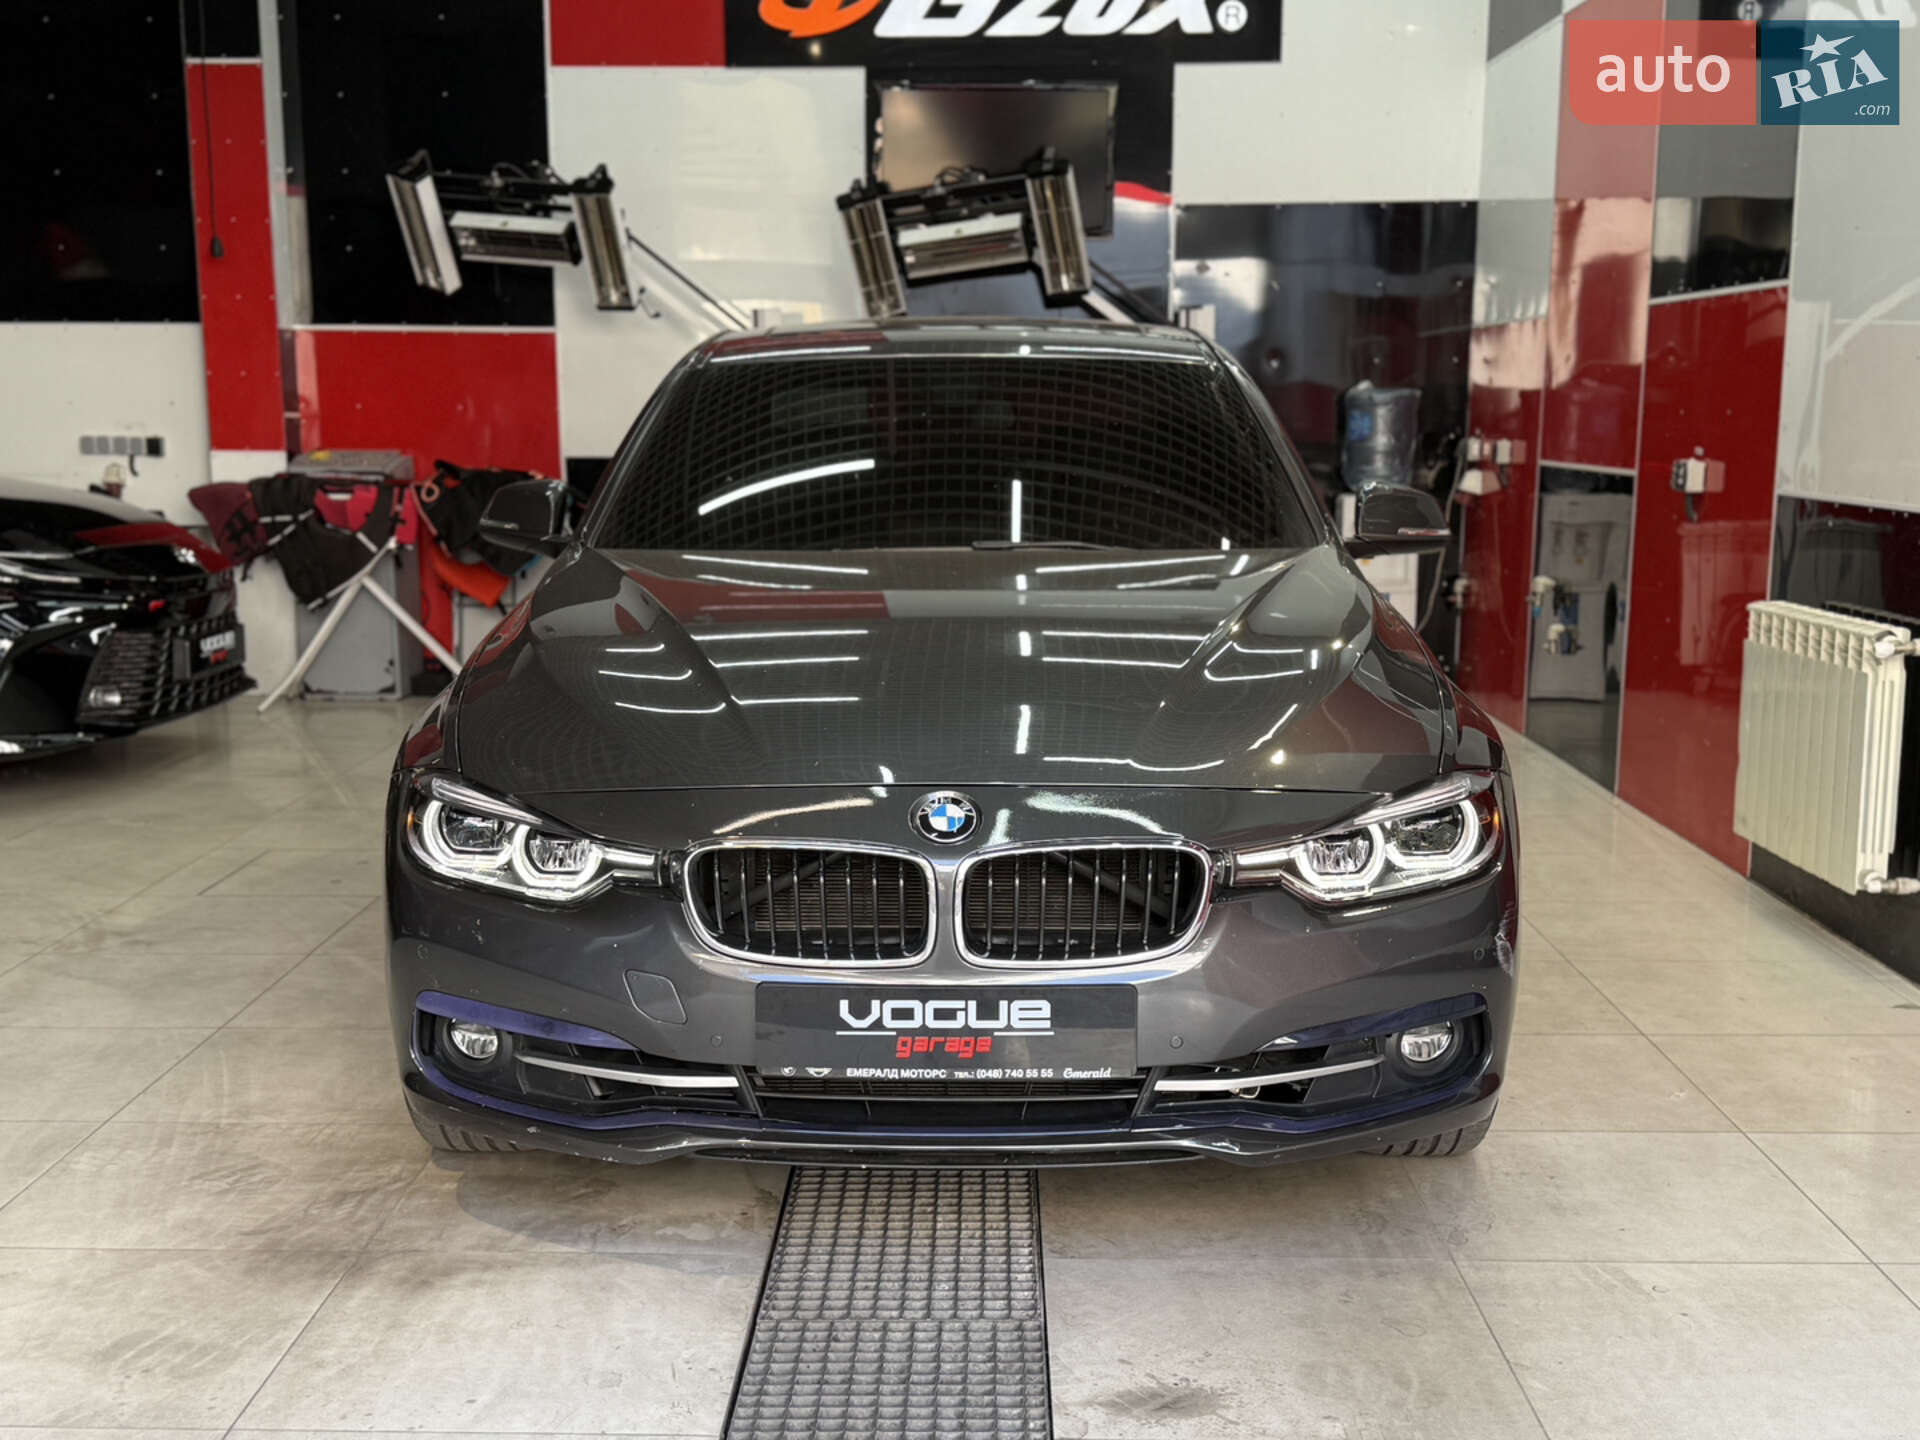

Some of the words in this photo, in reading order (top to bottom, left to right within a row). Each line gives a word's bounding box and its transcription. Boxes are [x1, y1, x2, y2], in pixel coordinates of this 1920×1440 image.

[839, 999, 1051, 1029] VOGUE
[895, 1036, 993, 1059] garage
[846, 1067, 899, 1079] ЕМЕРАЛД
[900, 1067, 947, 1079] МОТОРС
[1004, 1068, 1024, 1079] 740
[1025, 1068, 1039, 1079] 55
[1040, 1068, 1054, 1079] 55
[1063, 1066, 1112, 1079] Emerald
